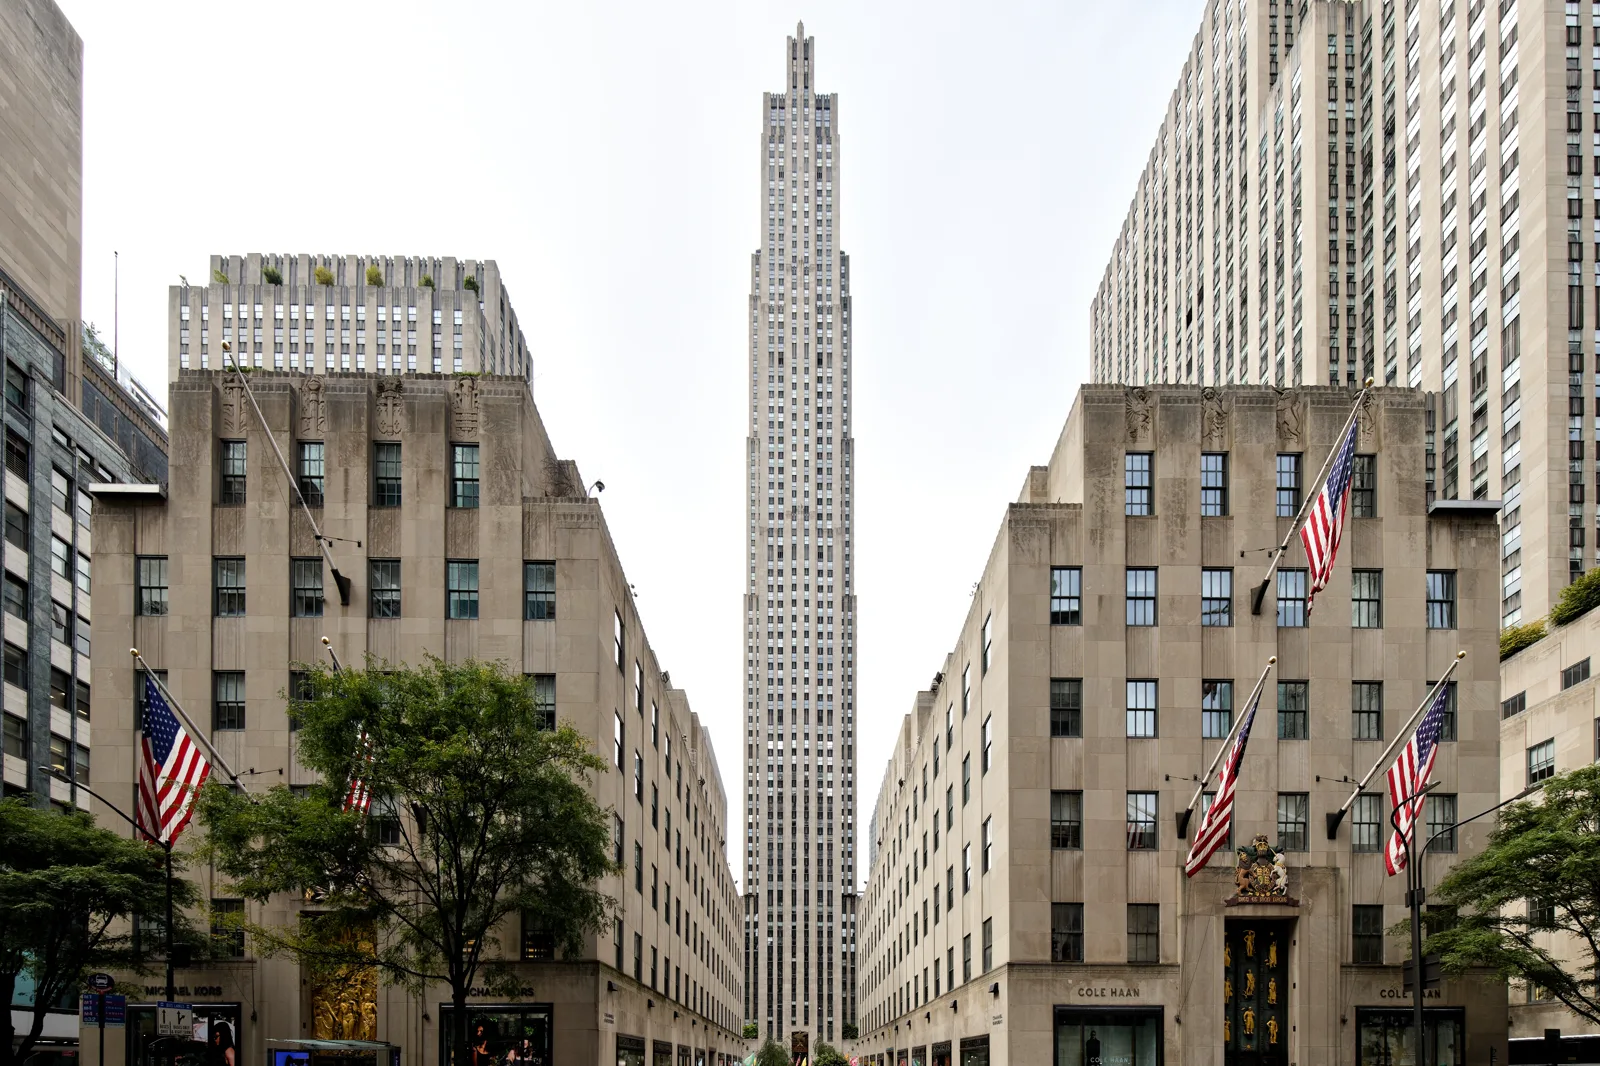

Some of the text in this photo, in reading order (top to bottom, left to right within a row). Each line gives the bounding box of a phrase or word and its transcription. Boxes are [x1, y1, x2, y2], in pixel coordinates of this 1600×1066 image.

[194, 986, 222, 996] KORS
[1078, 988, 1140, 997] COLE HAAN
[1380, 989, 1441, 998] COLE AAN
